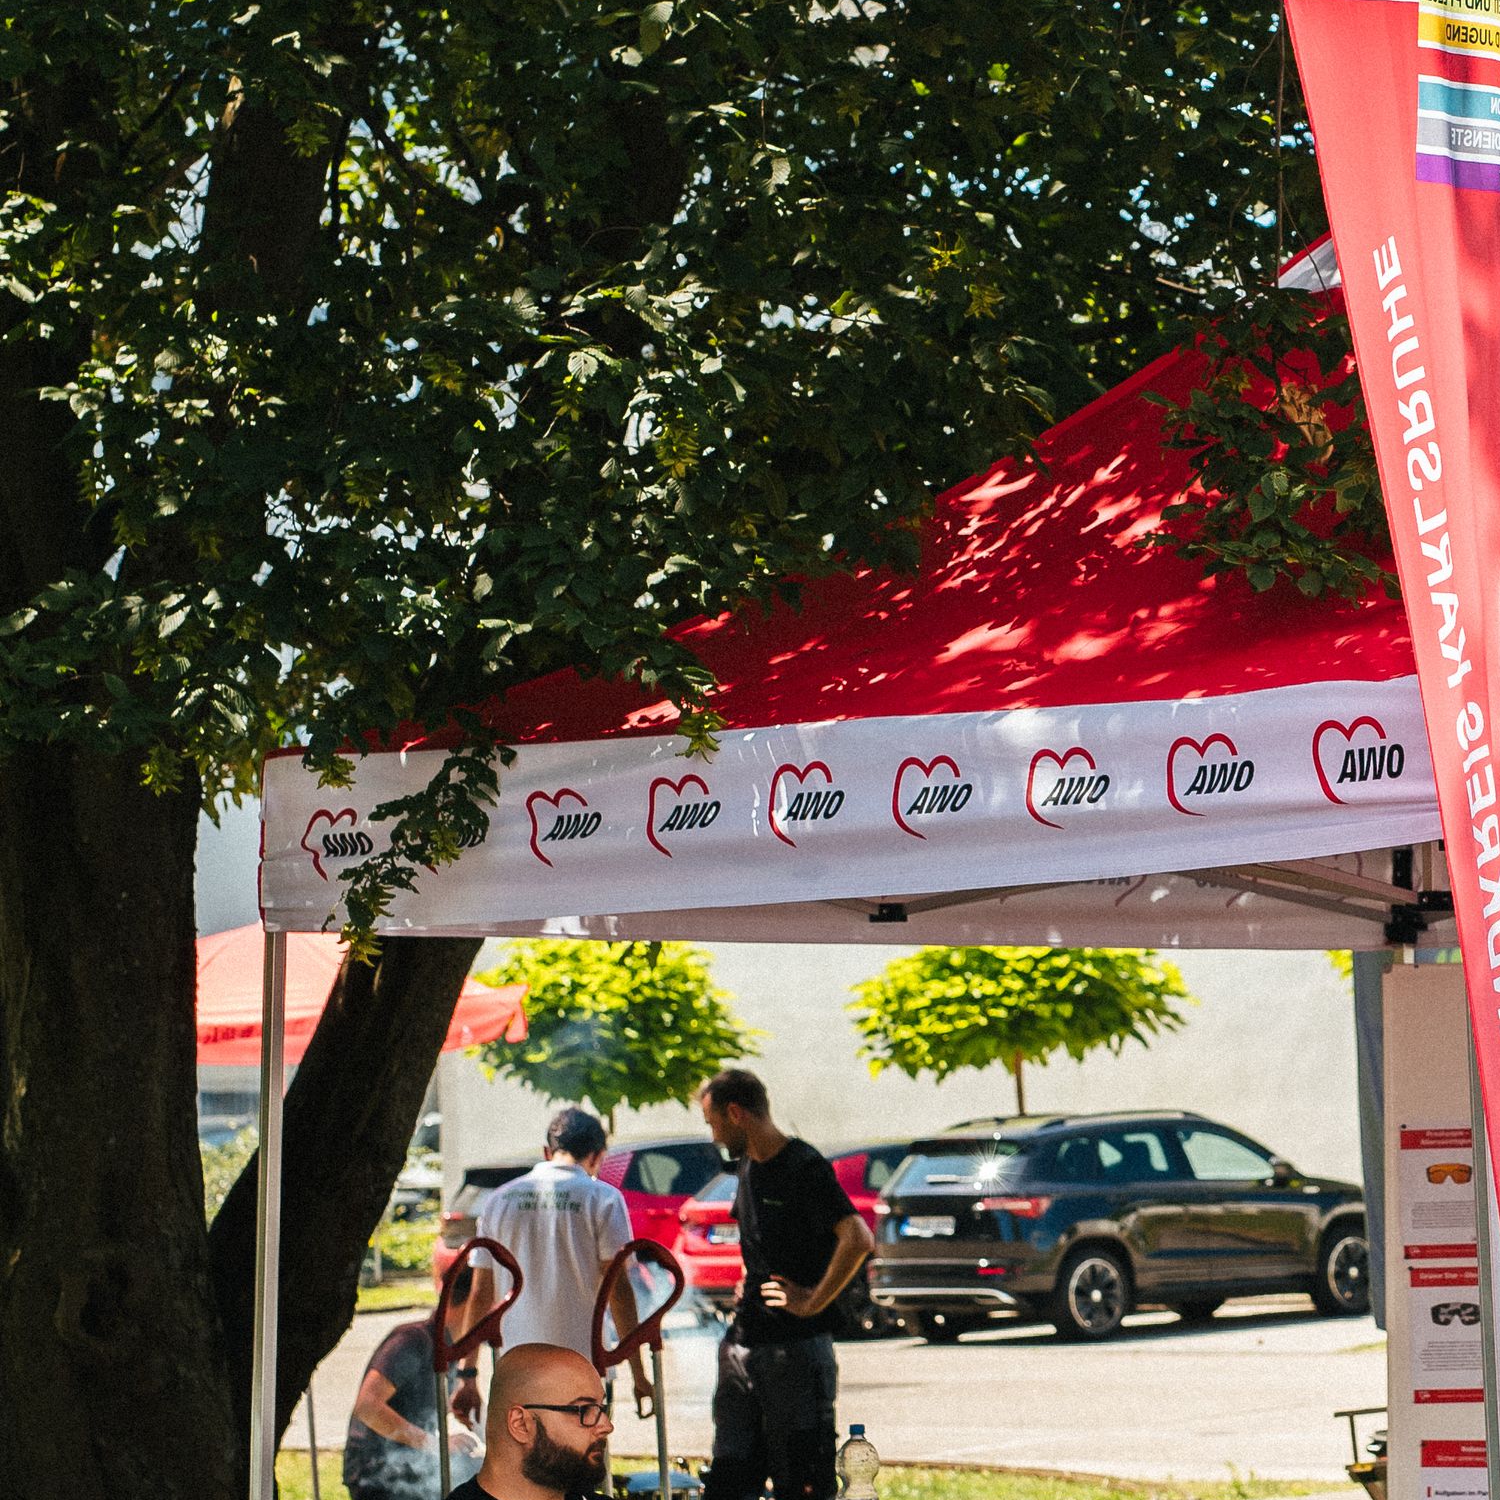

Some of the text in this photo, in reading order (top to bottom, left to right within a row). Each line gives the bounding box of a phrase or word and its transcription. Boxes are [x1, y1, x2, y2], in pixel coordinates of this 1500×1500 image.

[1184, 759, 1255, 796] AWO
[1336, 743, 1405, 784] AWO
[782, 789, 846, 822] AWO
[906, 783, 973, 816] AWO
[1042, 774, 1111, 807] AWO
[542, 812, 601, 842] AWO
[659, 800, 721, 833] AWO
[322, 831, 374, 859] AWO
